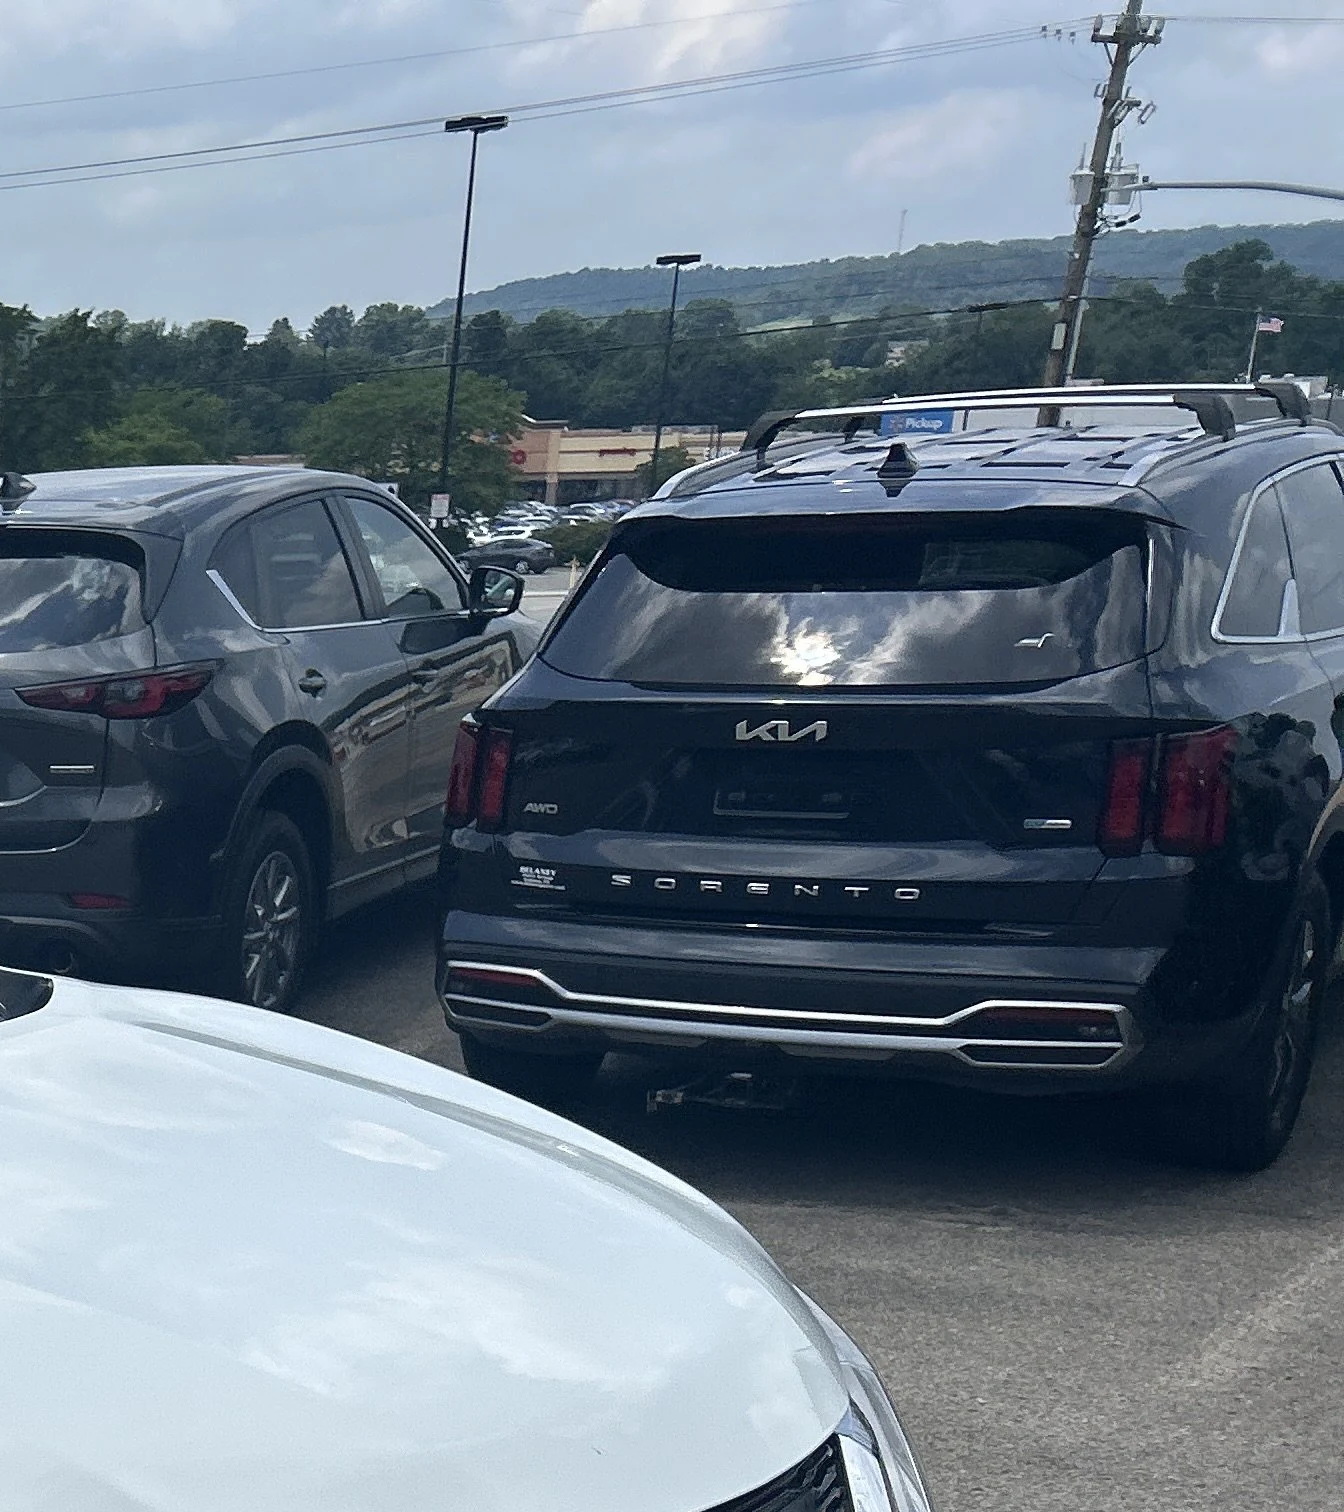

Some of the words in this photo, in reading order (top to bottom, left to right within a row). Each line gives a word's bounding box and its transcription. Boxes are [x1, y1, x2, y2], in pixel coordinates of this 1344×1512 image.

[905, 417, 943, 430] Pickup
[735, 719, 828, 742] KIA
[523, 802, 558, 814] AWD
[611, 874, 921, 900] SORENTO
